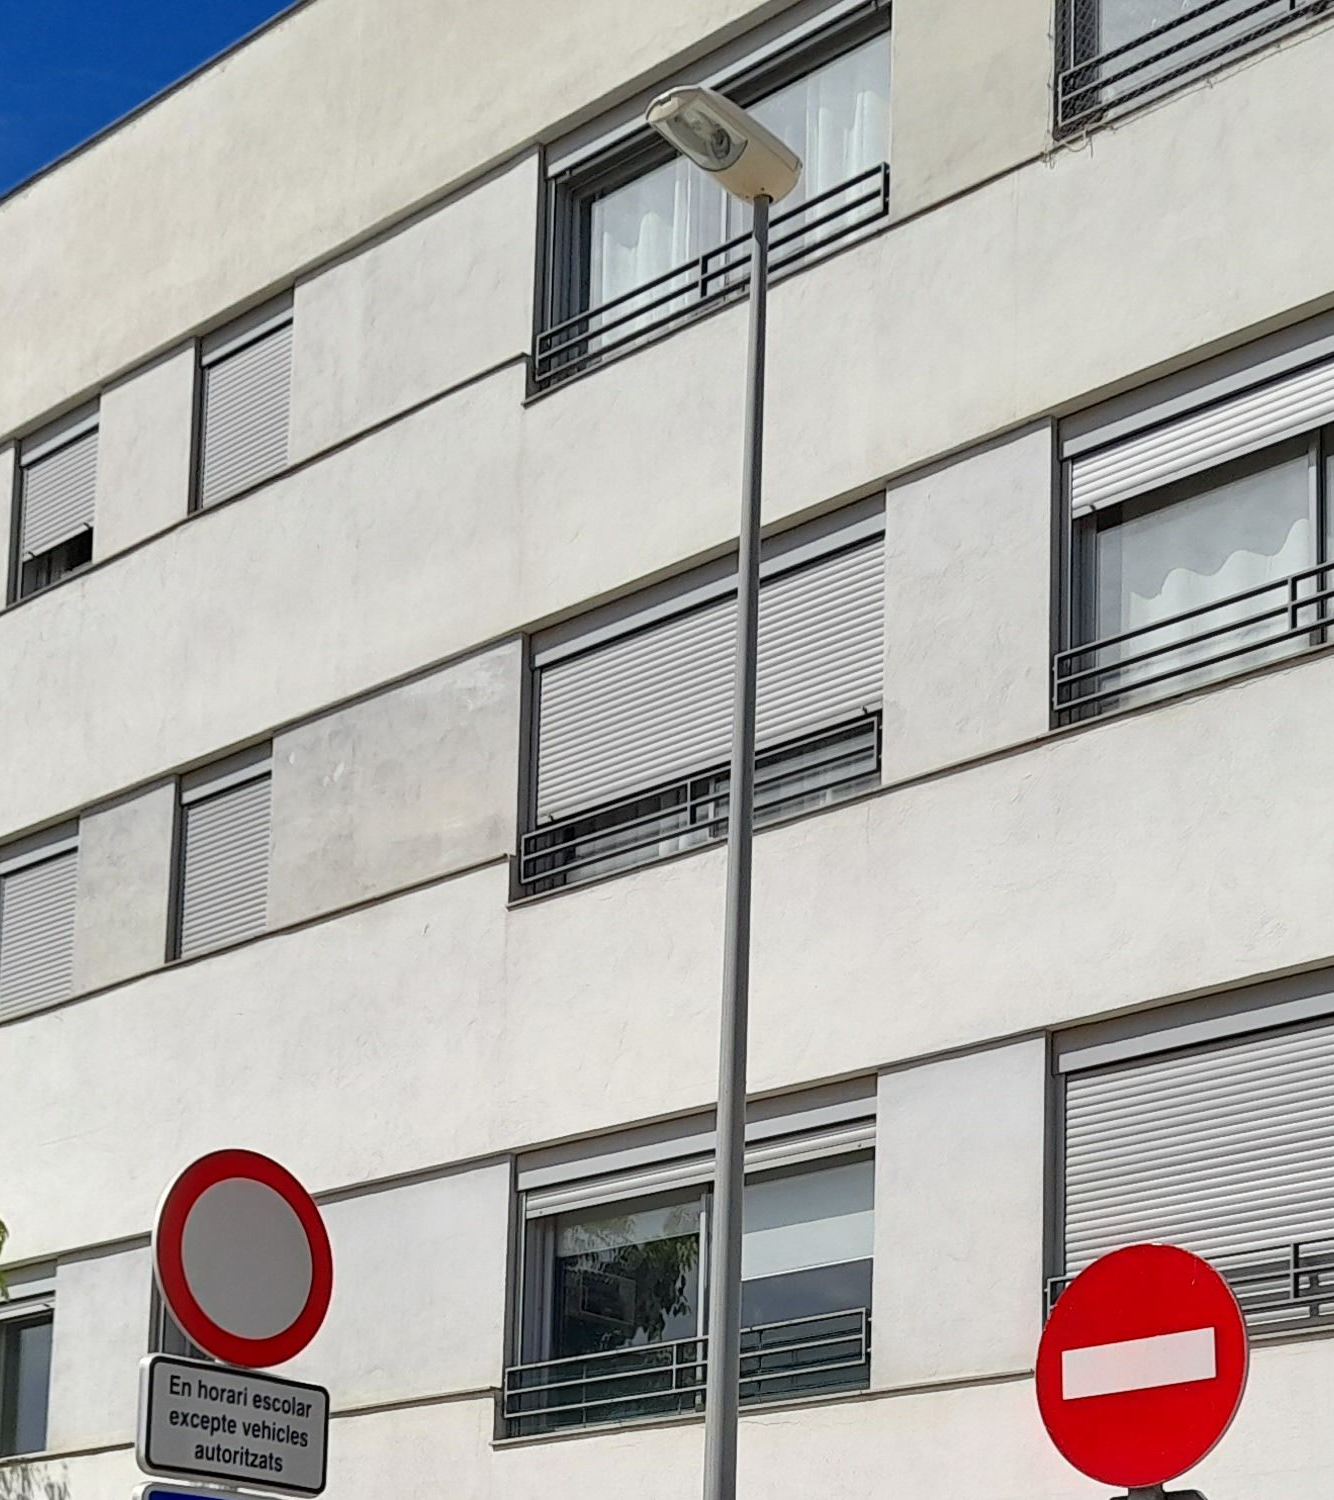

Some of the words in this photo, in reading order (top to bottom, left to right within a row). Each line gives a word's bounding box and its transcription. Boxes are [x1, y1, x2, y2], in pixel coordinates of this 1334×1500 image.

[170, 1375, 191, 1395] En
[198, 1380, 247, 1406] horari
[252, 1392, 312, 1418] escolar
[169, 1411, 236, 1436] excepte
[243, 1421, 308, 1447] vehicles
[194, 1445, 283, 1472] autoritzats
